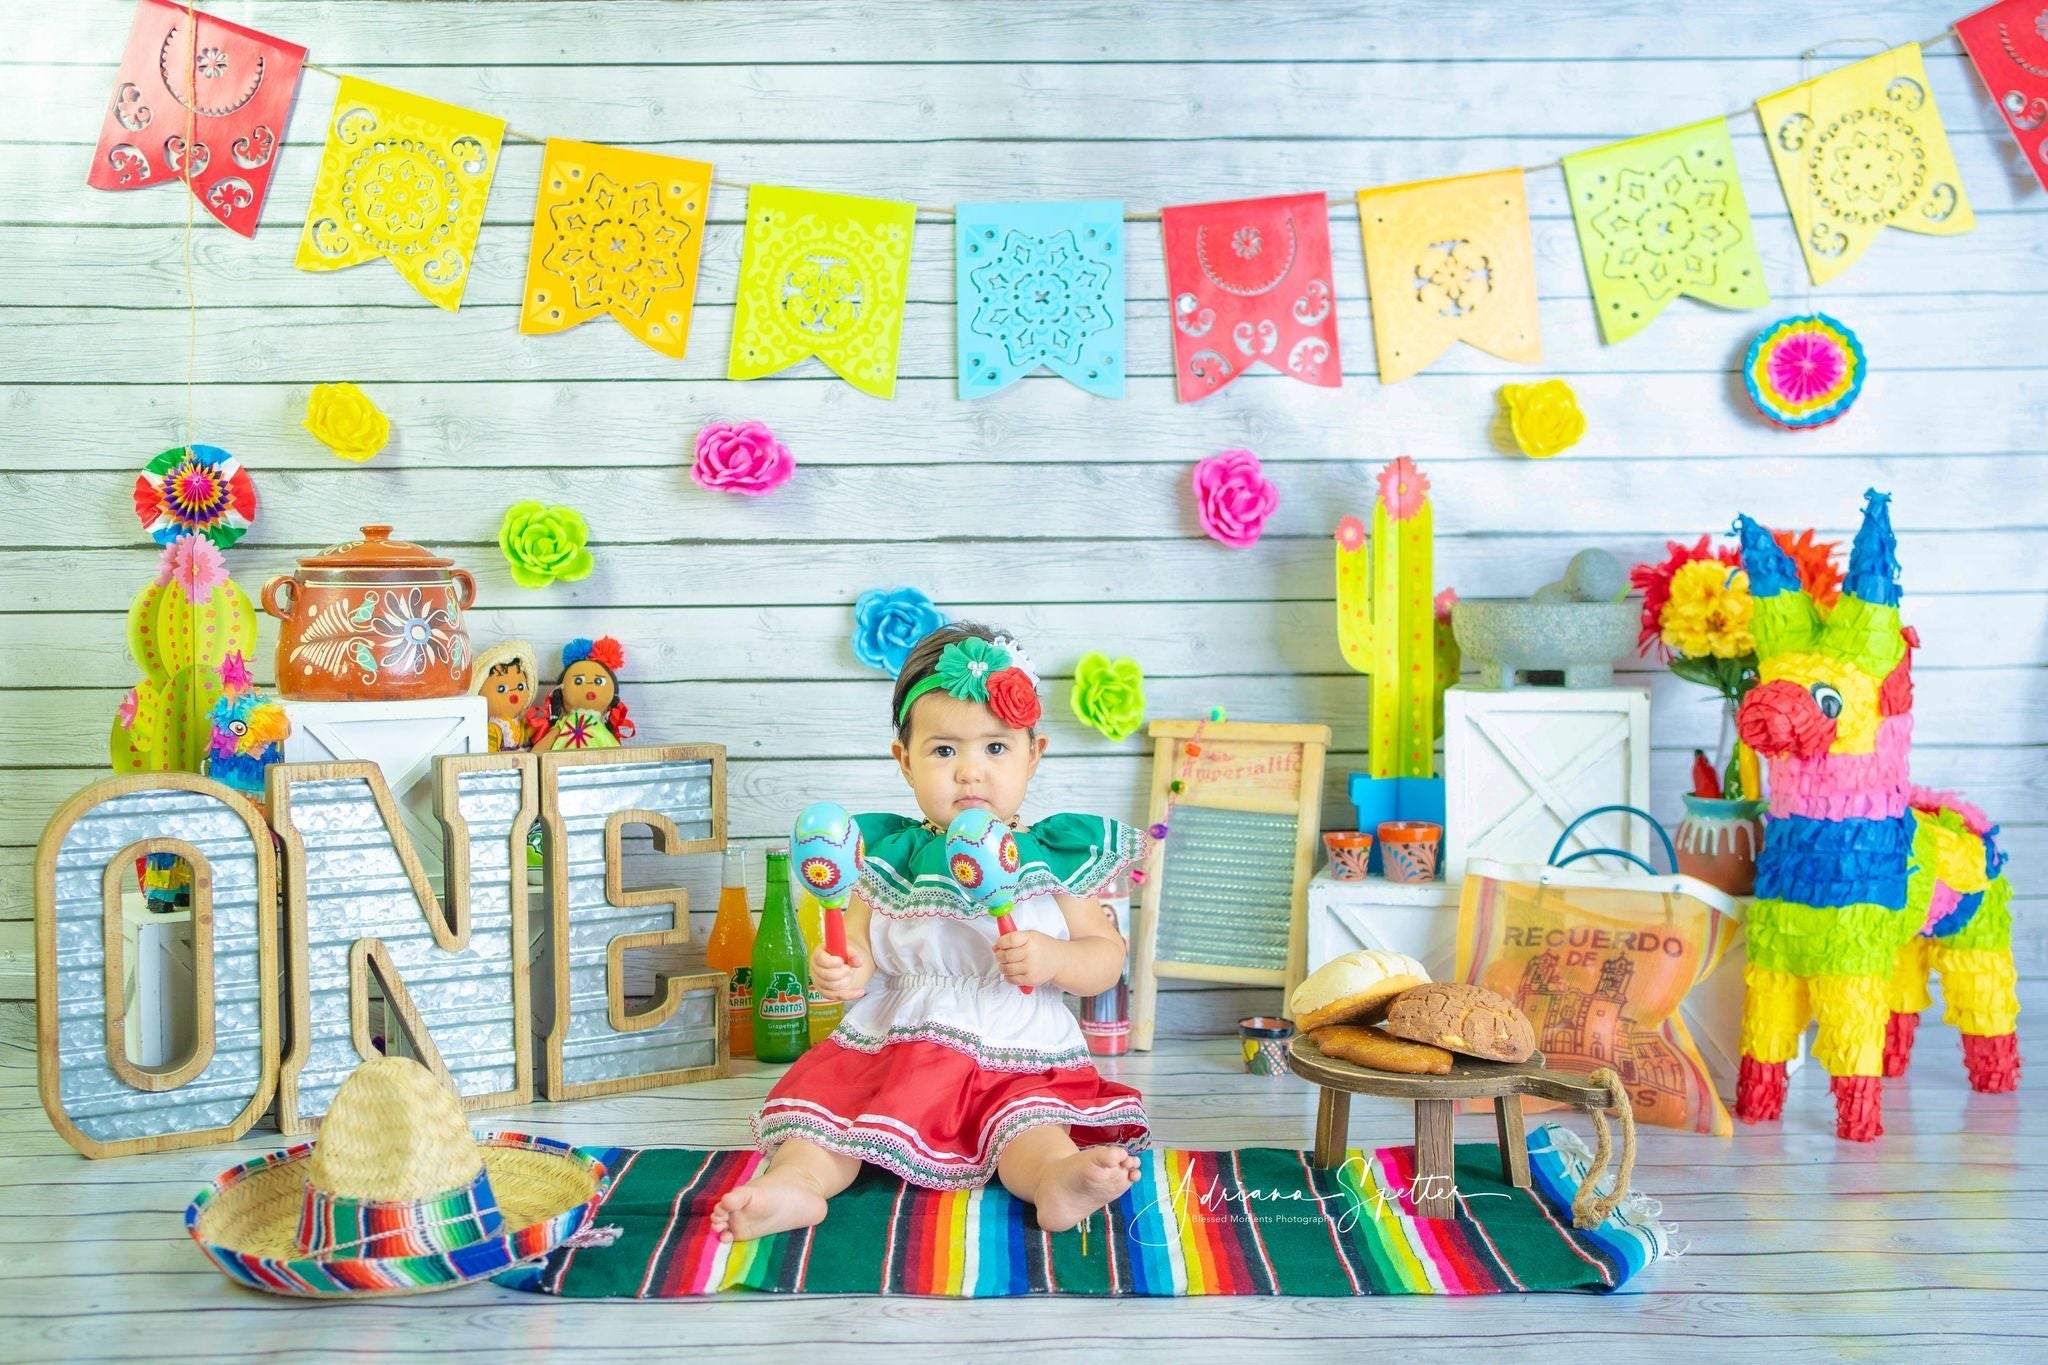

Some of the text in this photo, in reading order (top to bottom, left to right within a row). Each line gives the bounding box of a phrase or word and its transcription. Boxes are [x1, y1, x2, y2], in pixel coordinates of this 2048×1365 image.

[1504, 926, 1683, 957] RECUERDO
[34, 743, 730, 1160] ONE
[1565, 951, 1598, 967] DE
[729, 997, 753, 1007] ARRIT
[763, 1003, 803, 1014] JARRITOS
[767, 1022, 800, 1031] Grapefruit
